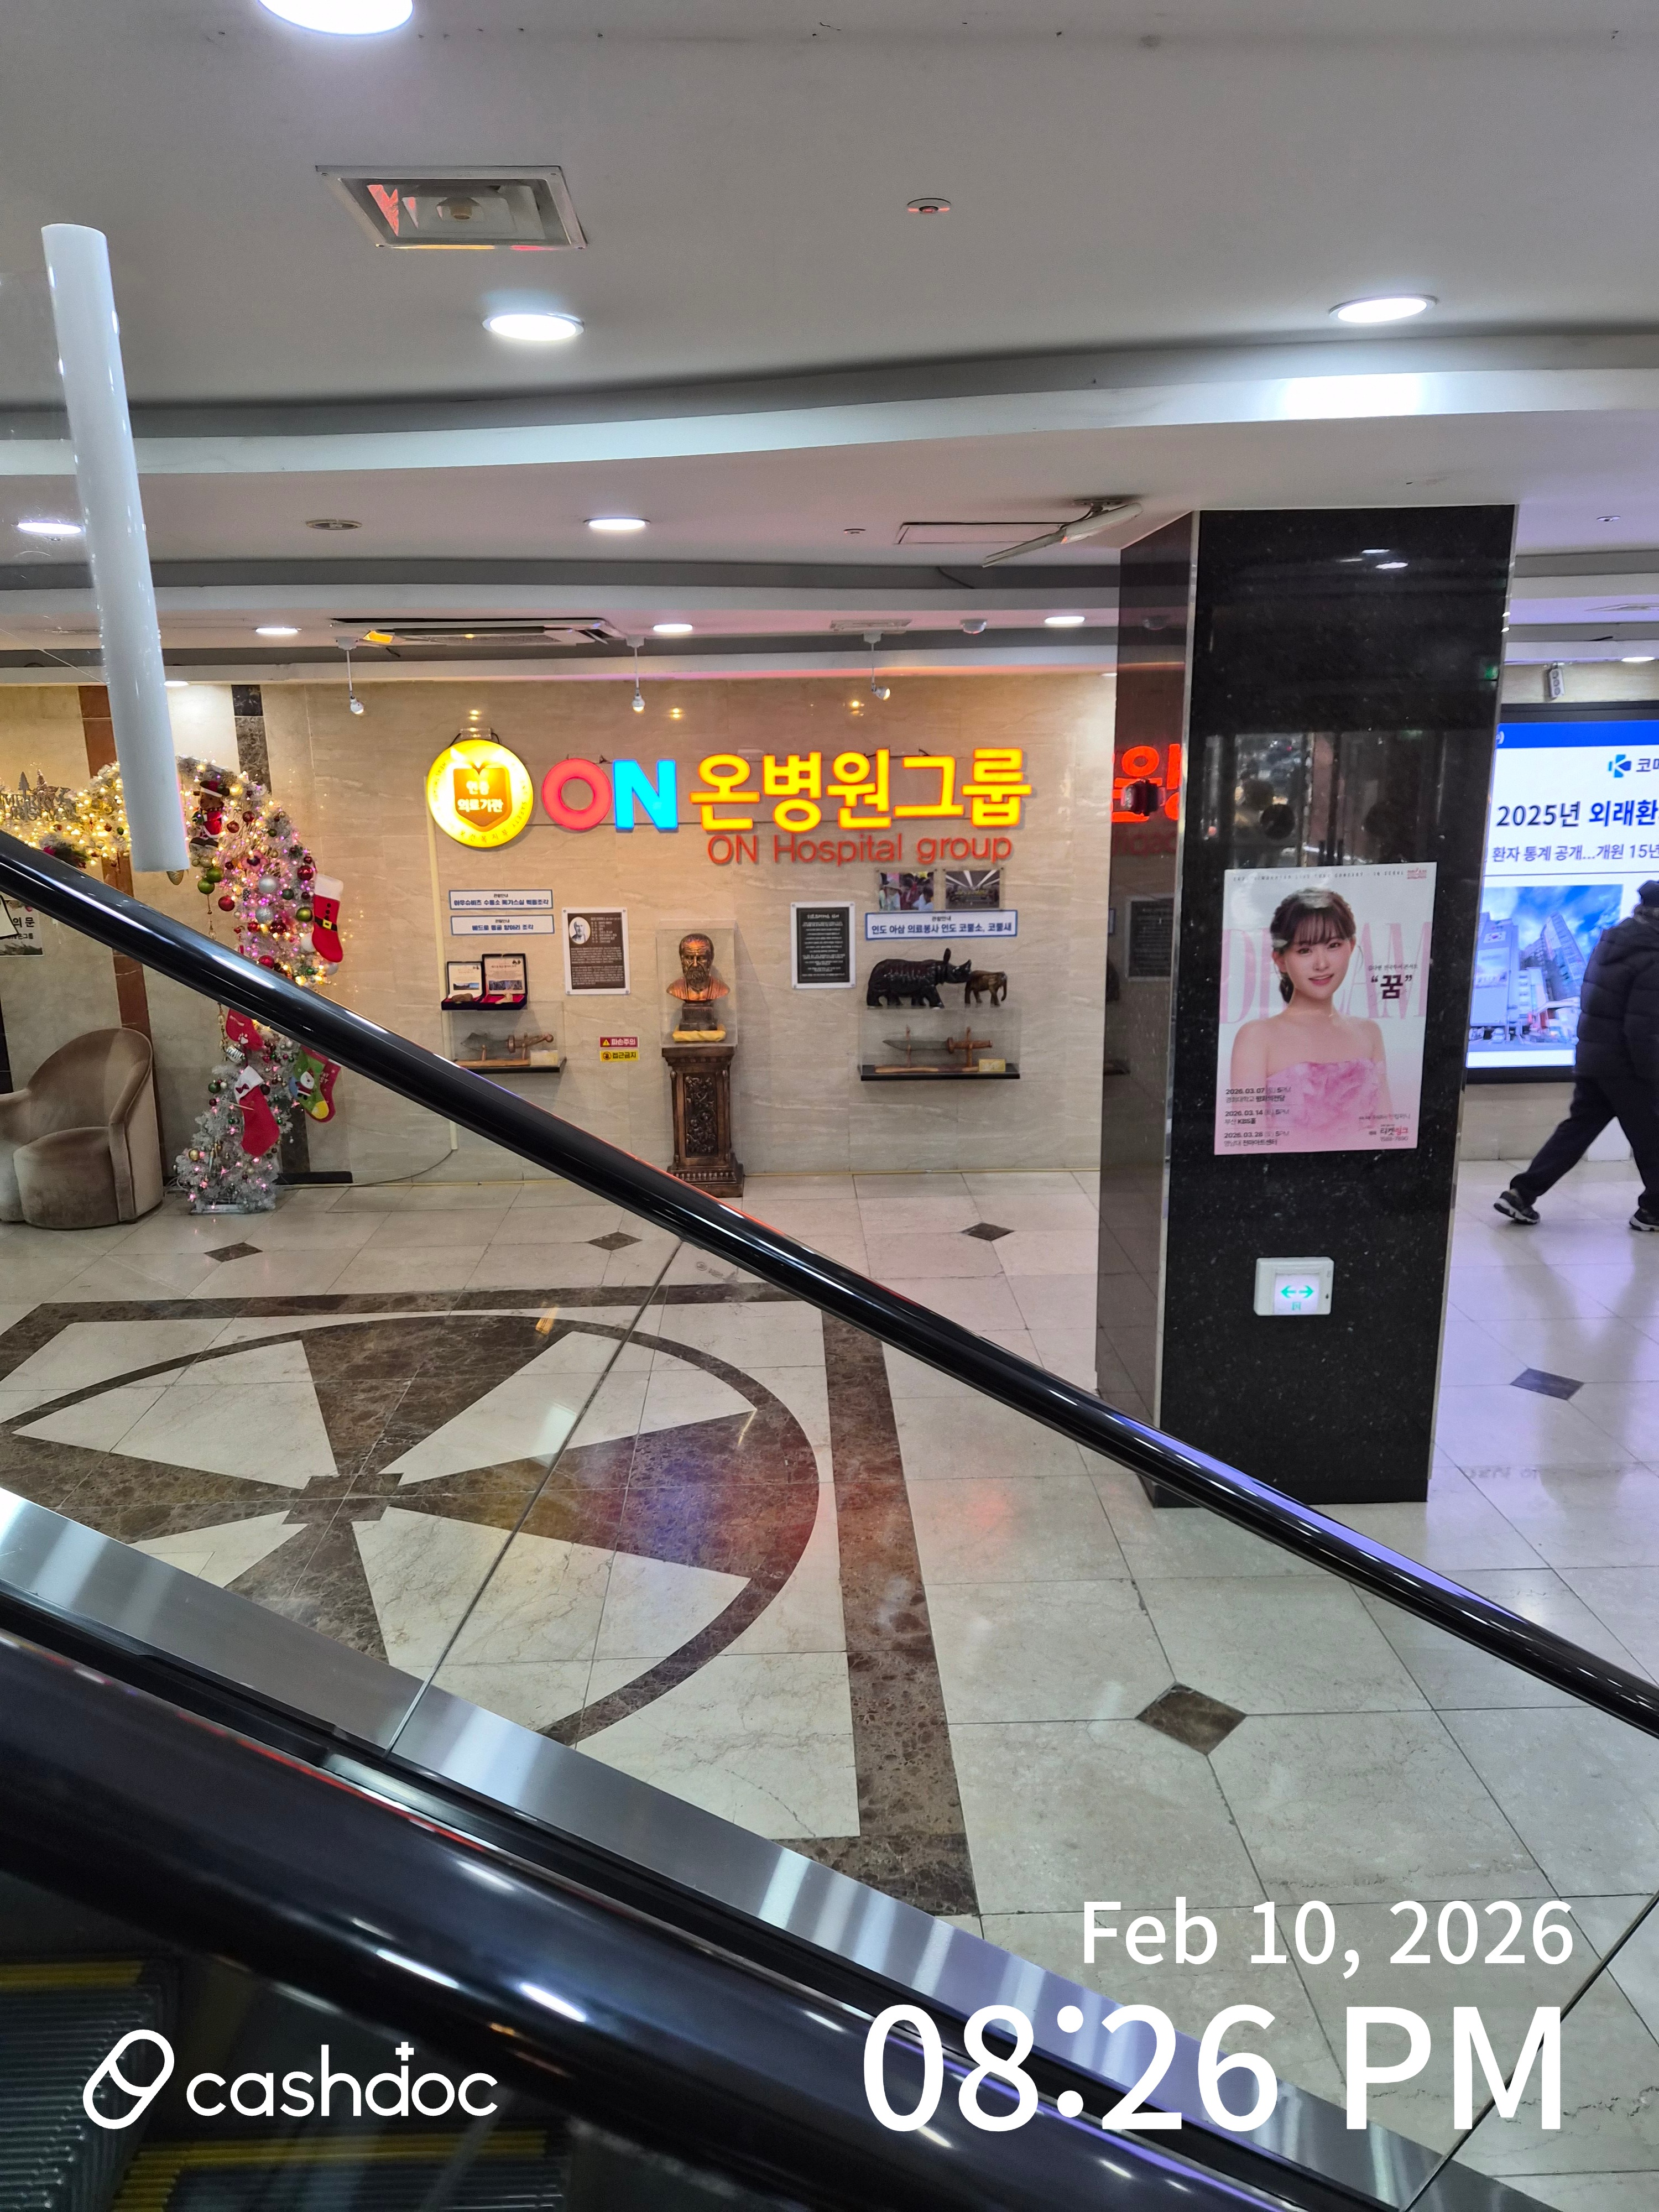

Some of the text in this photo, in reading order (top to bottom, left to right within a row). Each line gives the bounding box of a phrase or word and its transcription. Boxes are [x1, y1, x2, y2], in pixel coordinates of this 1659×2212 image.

[542, 758, 679, 830] ON
[690, 748, 1032, 833] 온병원그룹
[1496, 800, 1659, 827] 2025년 외래환
[708, 833, 1013, 867] ON Hospital group
[1493, 847, 1520, 862] 환자
[1524, 846, 1552, 861] 통계
[1629, 843, 1659, 859] 15년
[872, 925, 887, 935] 인도
[889, 925, 905, 935] 아삼
[907, 924, 939, 934] 의료봉사
[941, 924, 957, 933] 인도
[1220, 921, 1432, 1024] DAM
[611, 1038, 636, 1046] 파손주의
